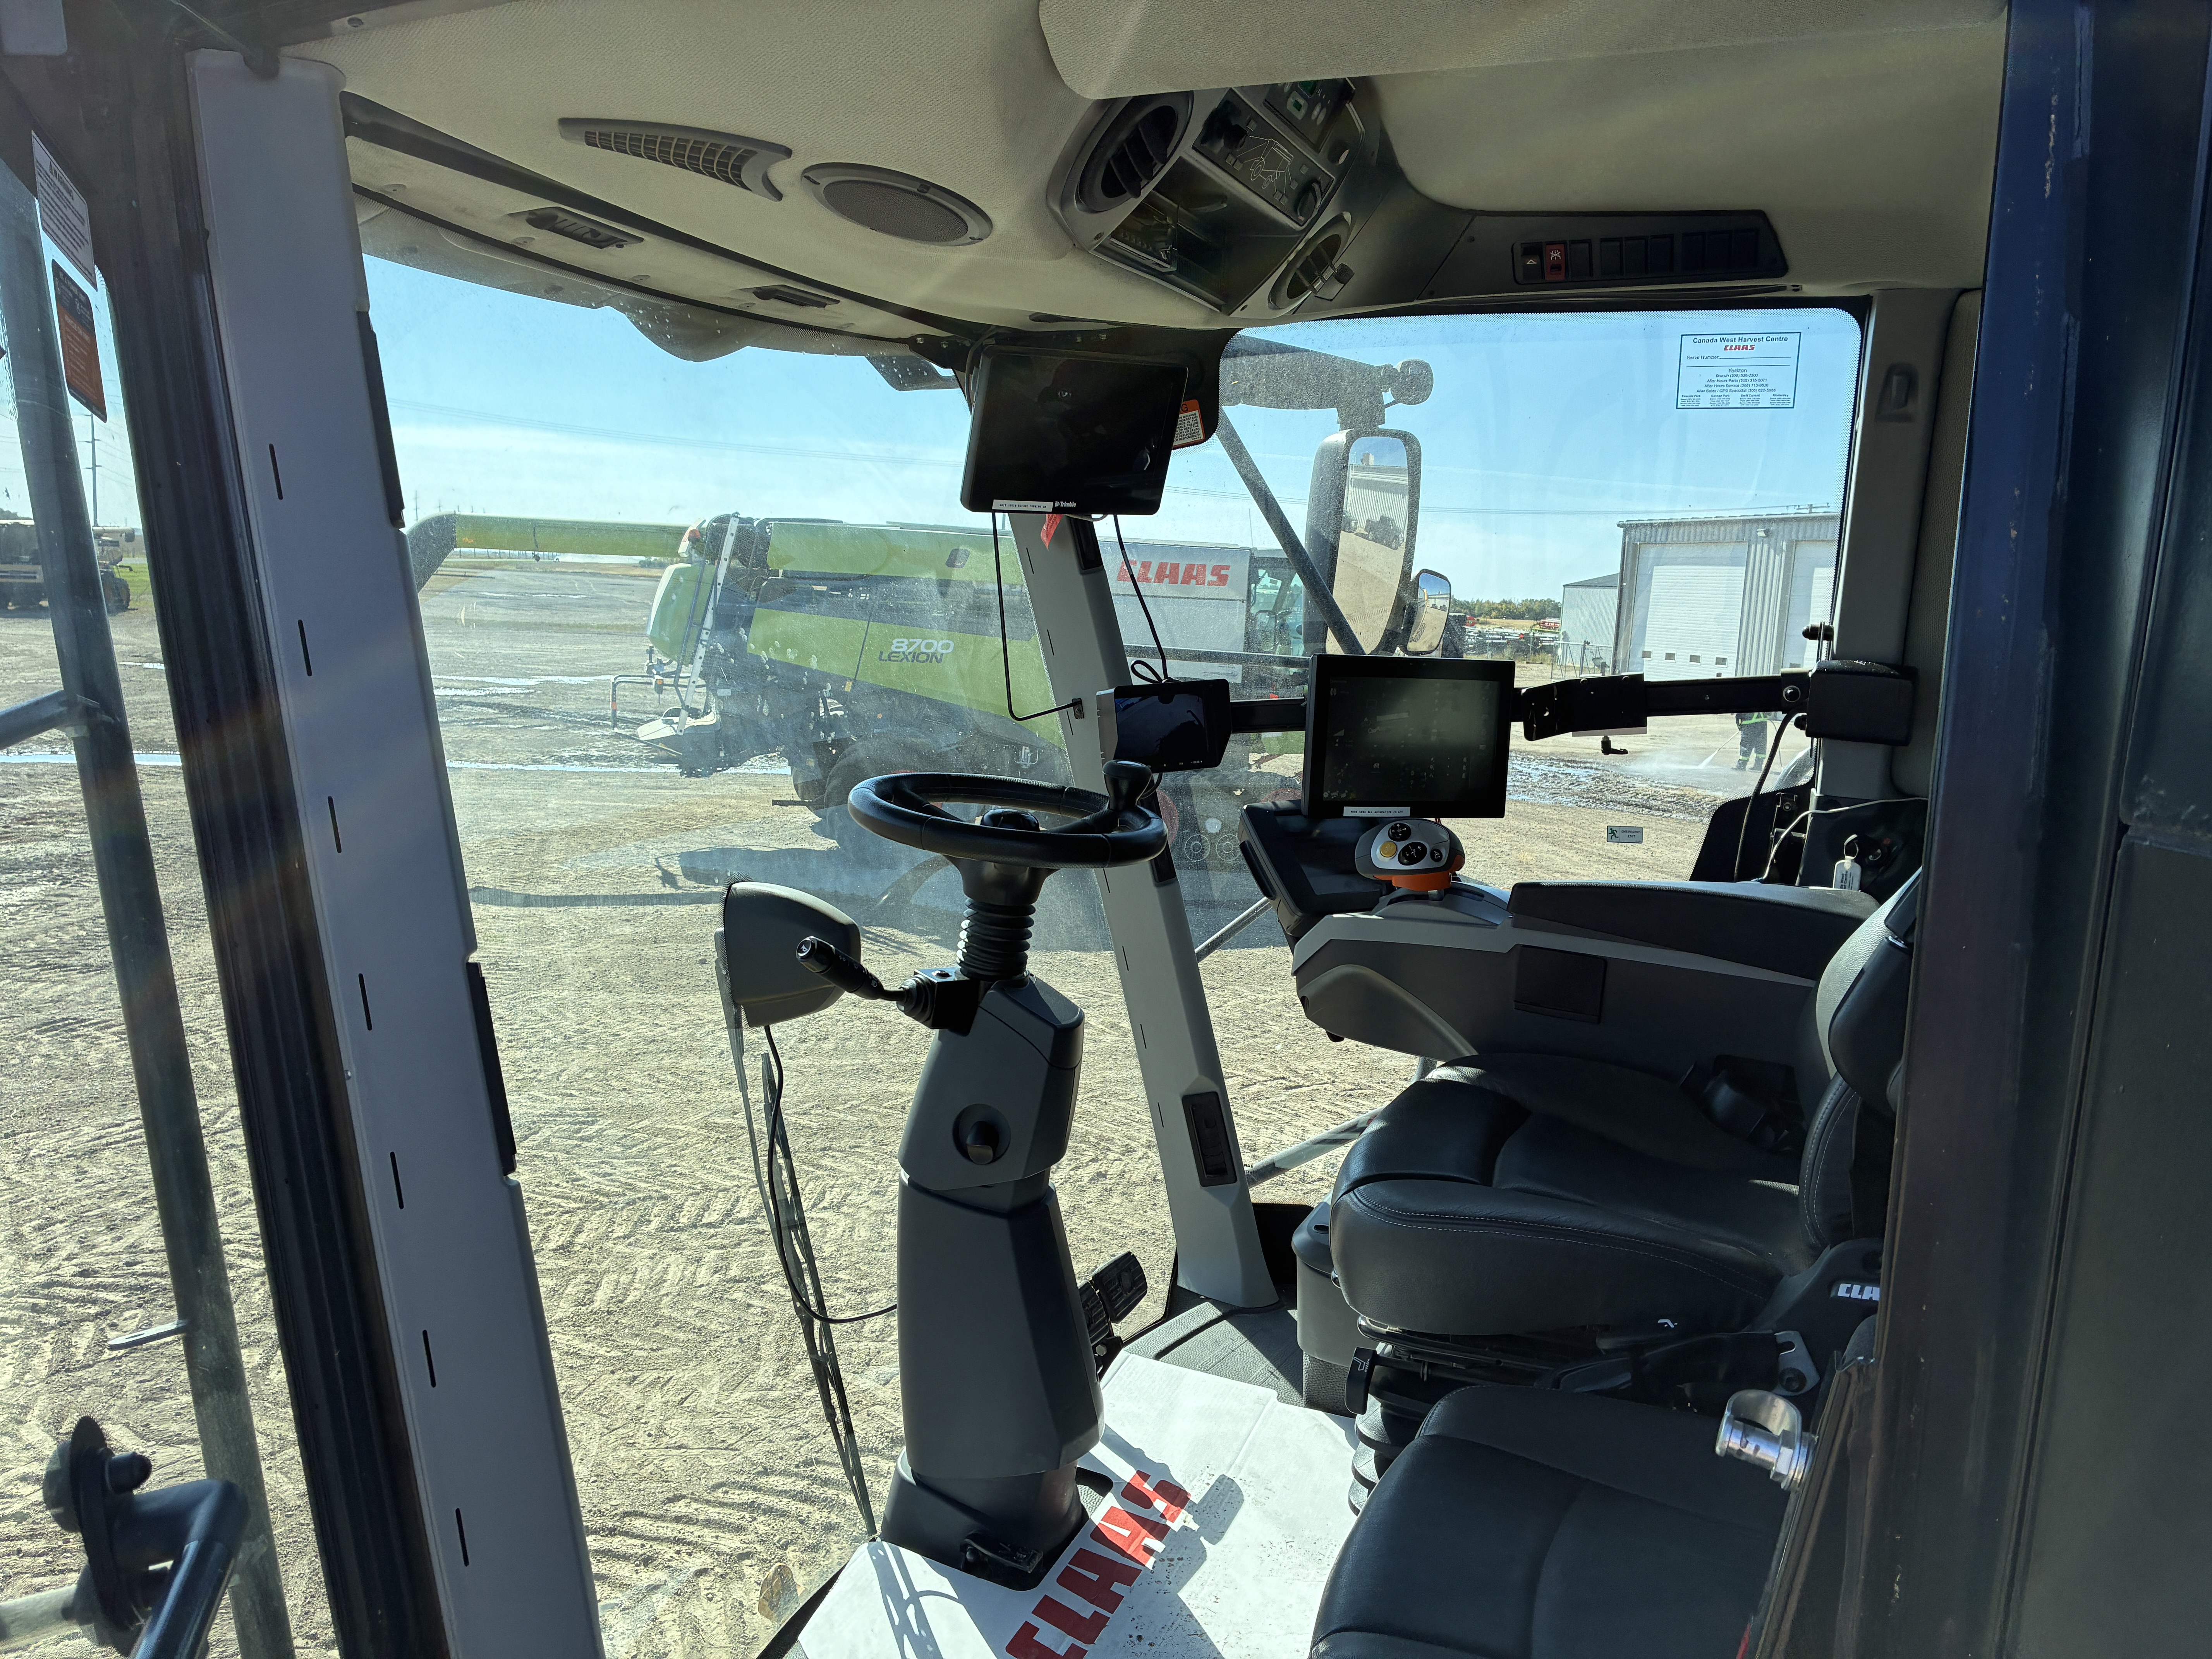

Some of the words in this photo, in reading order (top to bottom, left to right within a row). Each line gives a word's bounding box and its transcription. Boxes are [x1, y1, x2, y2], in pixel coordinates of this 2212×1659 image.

[1117, 560, 1230, 587] CLAAS
[891, 638, 954, 653] 8700
[878, 651, 944, 664] LEXION
[1838, 1283, 1880, 1301] CLA
[1005, 1470, 1191, 1659] CLAAS
